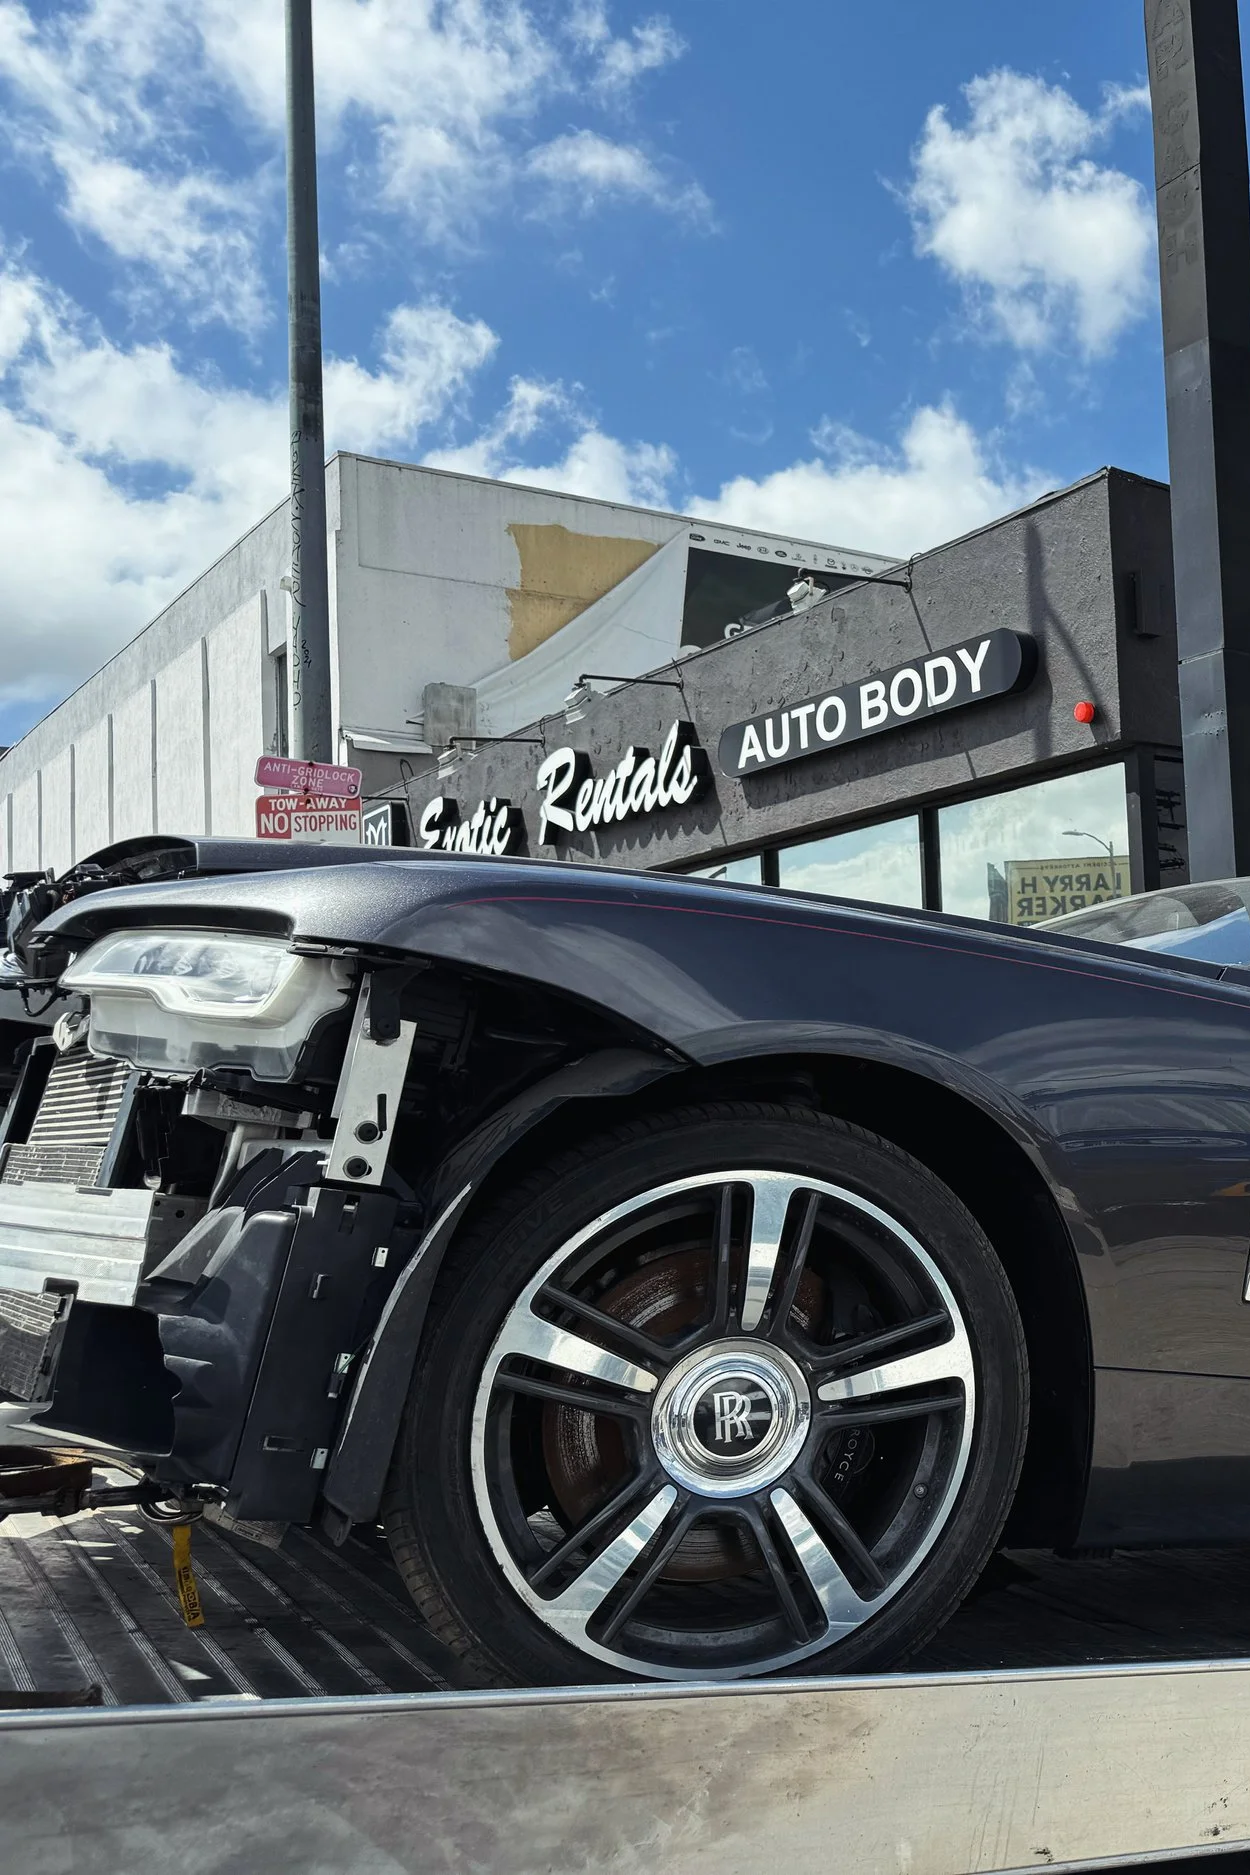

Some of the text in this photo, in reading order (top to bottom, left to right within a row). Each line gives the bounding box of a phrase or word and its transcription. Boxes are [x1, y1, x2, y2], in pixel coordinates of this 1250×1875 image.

[738, 639, 991, 769] AUTO BODY
[264, 761, 355, 783] ANTI-GRIDLOCK
[291, 775, 324, 788] ZONE
[537, 719, 698, 846] Rentals
[268, 798, 347, 811] TOW-AWAY
[260, 813, 357, 834] NO STOPPING
[834, 1428, 861, 1481] ROYCE
